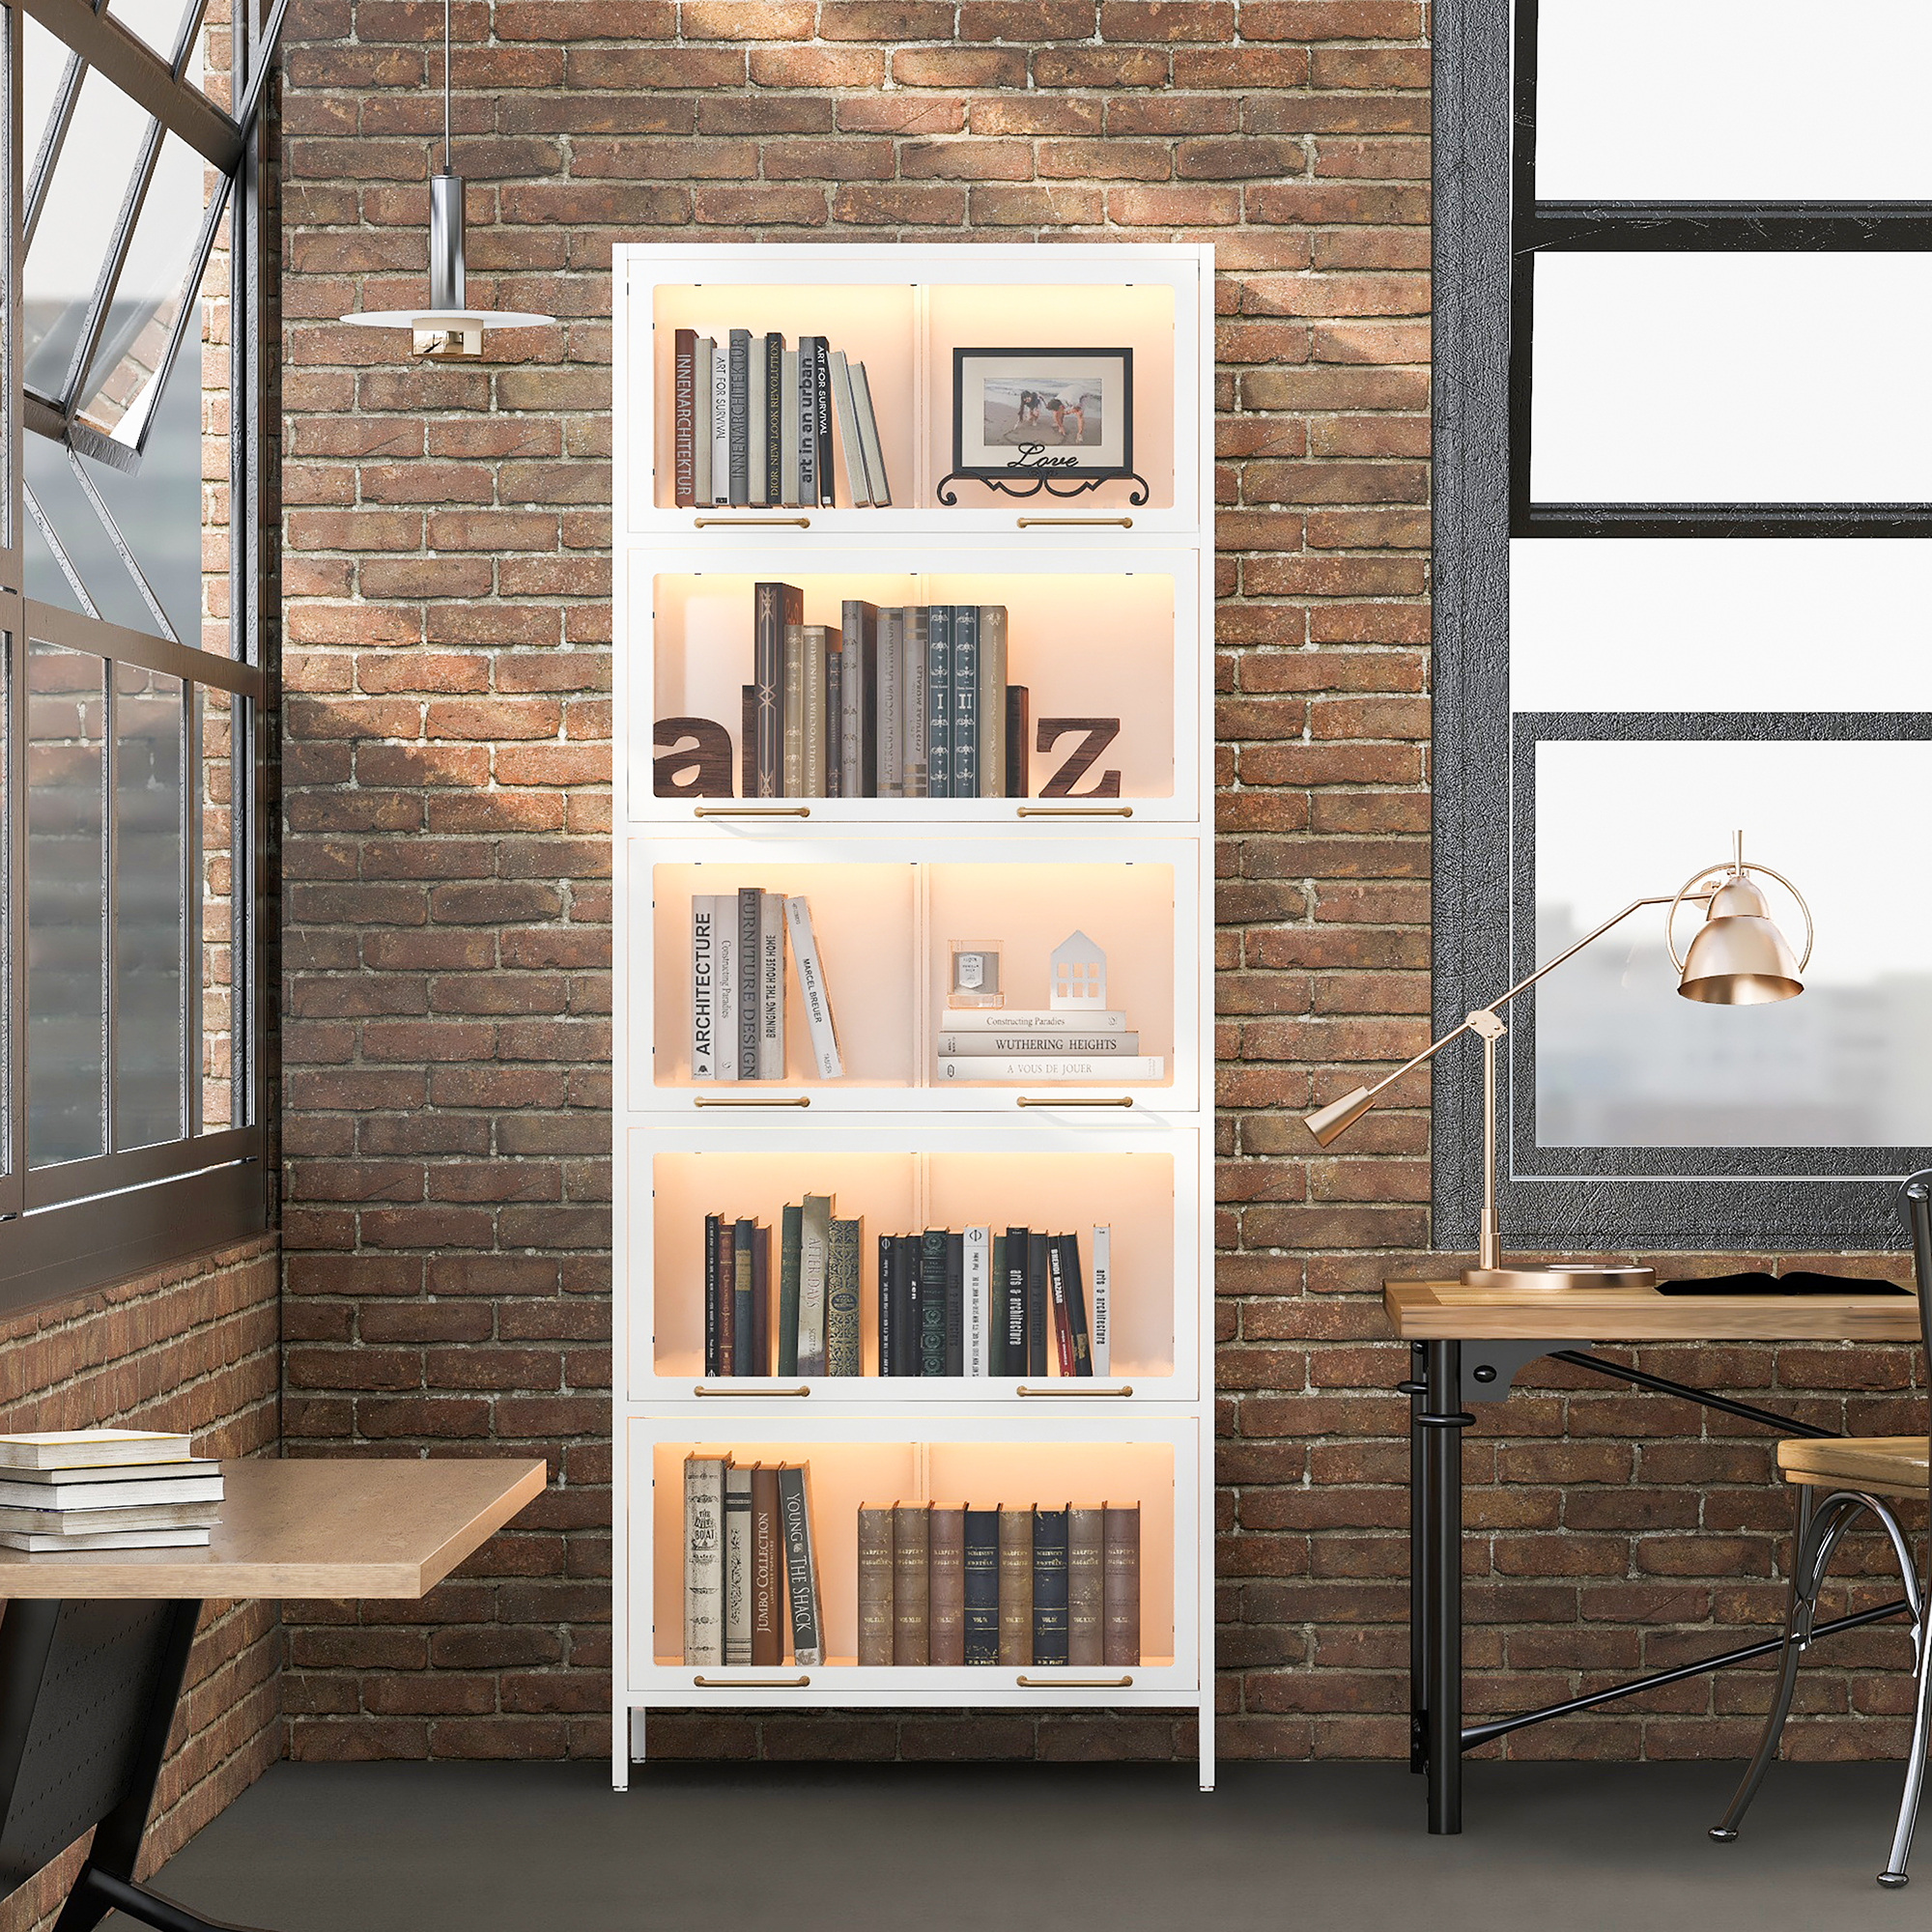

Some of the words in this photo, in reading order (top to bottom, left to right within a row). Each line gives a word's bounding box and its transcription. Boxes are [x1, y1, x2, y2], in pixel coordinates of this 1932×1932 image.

[716, 356, 725, 375] ART
[816, 346, 825, 364] ART
[716, 377, 725, 396] FOR
[771, 340, 780, 409] REVOLUTION
[799, 356, 813, 407] urban
[716, 399, 726, 440] SURVIVAL
[730, 338, 746, 479] INNENARCHITEKTUR
[803, 411, 813, 434] an
[818, 390, 827, 435] SURVIVAL
[676, 354, 692, 496] INNENARCHITEKTUR
[770, 412, 779, 440] LOOK
[770, 441, 779, 466] NEW
[799, 438, 813, 454] in
[1008, 442, 1079, 468] Love
[770, 468, 779, 497] DIOR.
[800, 456, 813, 484] art
[885, 685, 895, 723] VOCUM
[743, 891, 756, 1003] FURNITURE
[766, 934, 776, 956] HOME
[720, 940, 731, 987] Constructing
[766, 958, 776, 982] HOUSE
[696, 913, 711, 1056] ARCHITECTURE
[766, 983, 776, 1001] THE
[803, 958, 815, 991] MARCEL
[810, 991, 822, 1023] BREUER
[766, 1002, 776, 1038] BRINGING
[986, 1017, 1033, 1027] Constructing
[1035, 1017, 1065, 1026] Paradies
[743, 1009, 756, 1079] DESIGN
[995, 1038, 1064, 1050] WUTHERING
[1068, 1038, 1117, 1050] HEIGHTS
[1007, 1065, 1014, 1074] A
[1018, 1065, 1042, 1074] VOUS
[1045, 1065, 1059, 1074] DE
[1063, 1065, 1093, 1074] JOUER
[808, 1237, 821, 1274] AFTER
[1051, 1249, 1061, 1275] BHENDI
[1009, 1269, 1022, 1286] arts
[1053, 1276, 1064, 1304] BAZAAR
[1096, 1269, 1106, 1286] arts
[807, 1278, 820, 1308] DAYS
[1009, 1297, 1023, 1346] architecture
[1096, 1297, 1106, 1346] architecture
[786, 1492, 804, 1542] YOUNG
[755, 1512, 769, 1588] COLLECTION
[790, 1555, 807, 1583] THE
[757, 1591, 771, 1633] JUMBO
[793, 1587, 811, 1633] SHACK
